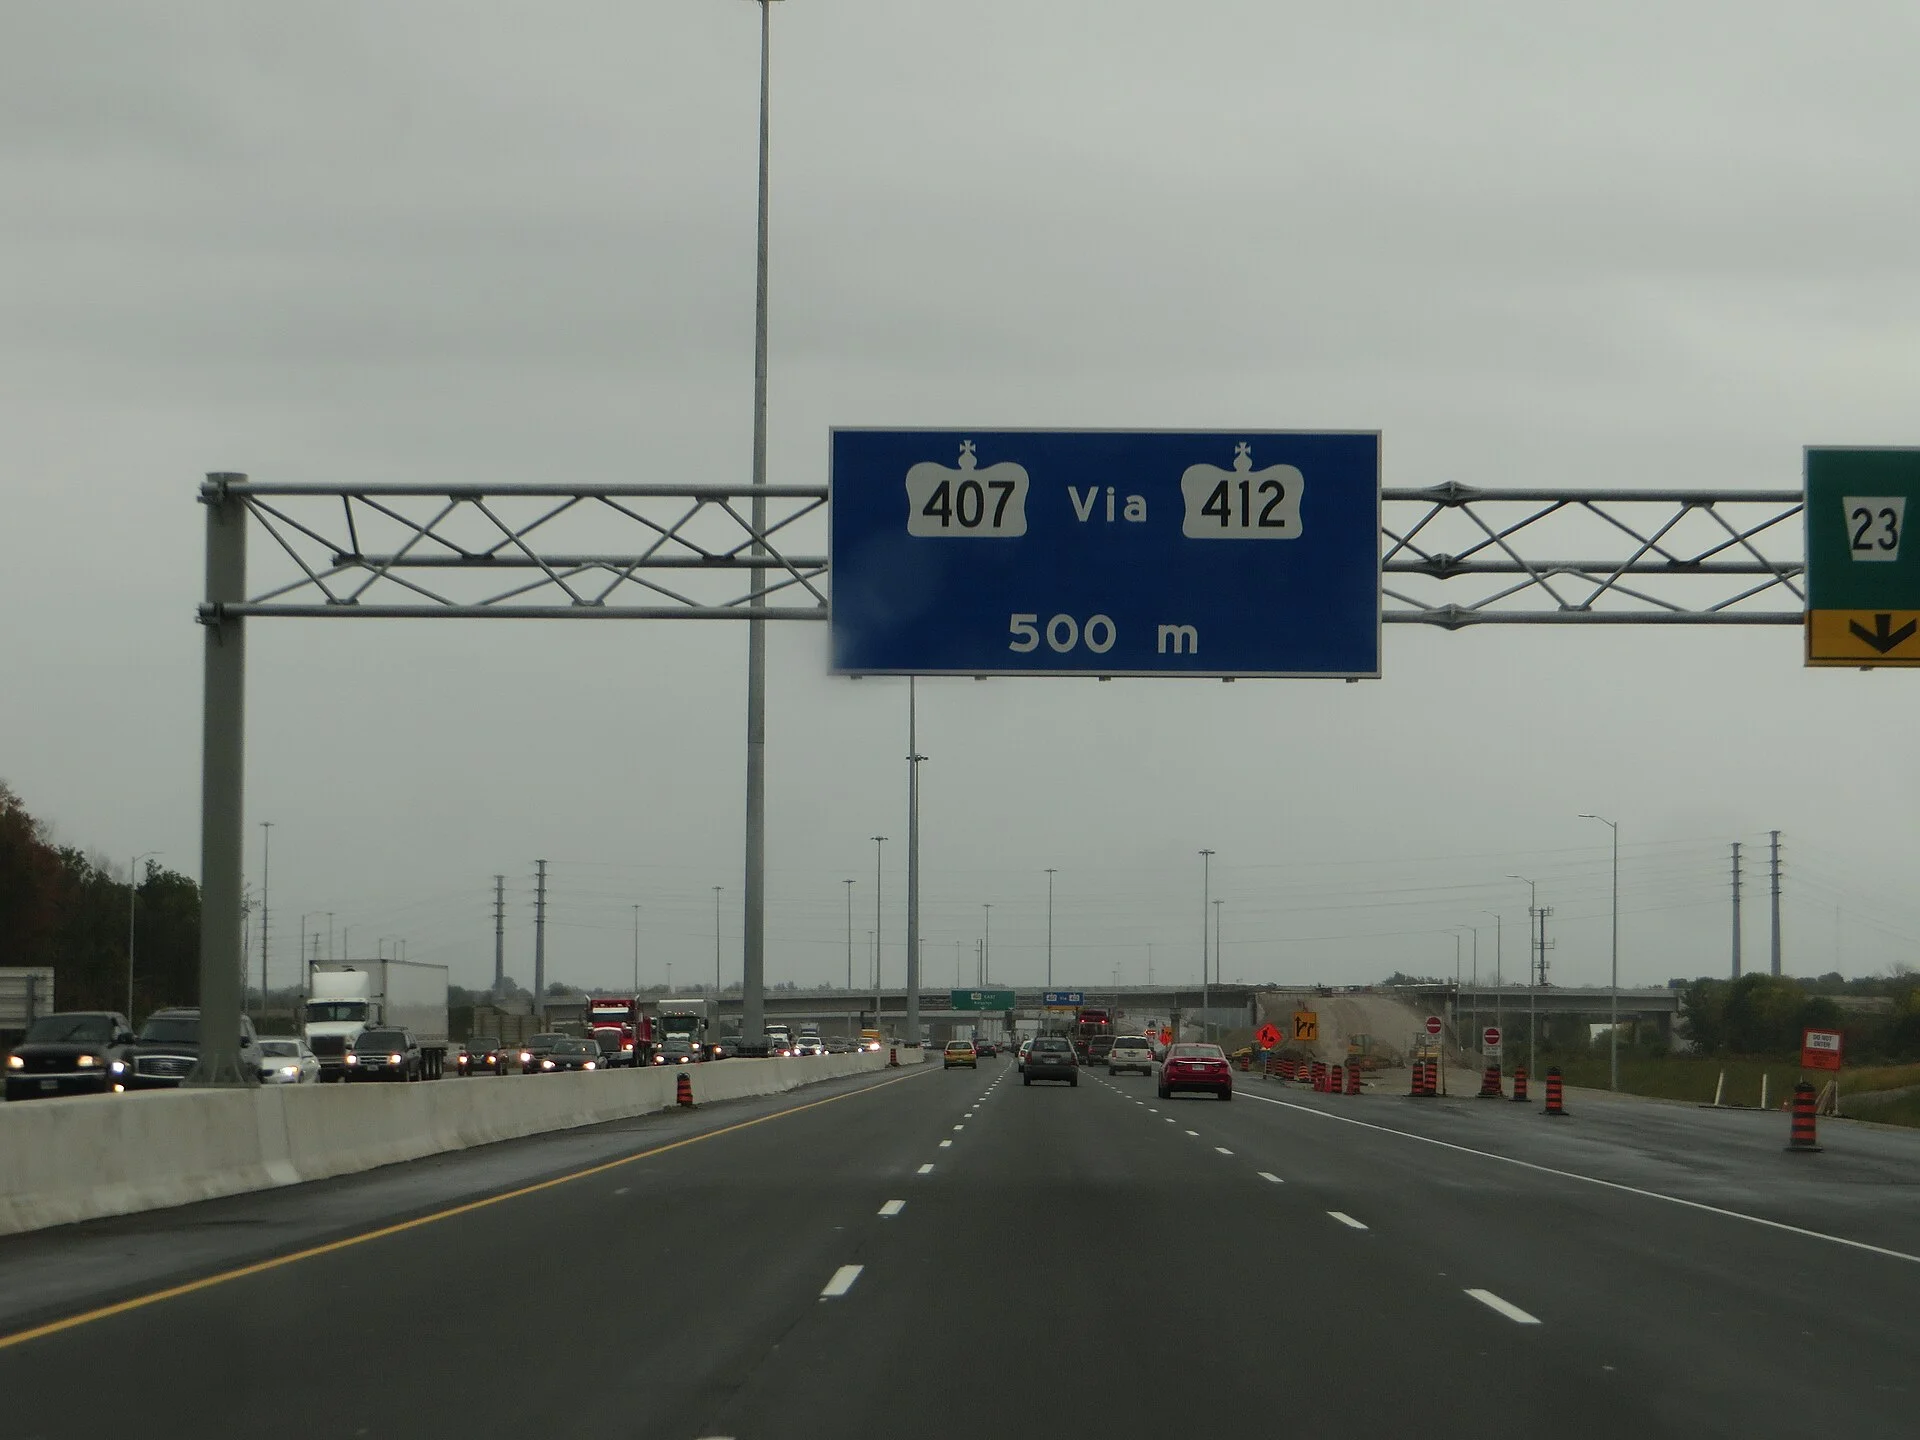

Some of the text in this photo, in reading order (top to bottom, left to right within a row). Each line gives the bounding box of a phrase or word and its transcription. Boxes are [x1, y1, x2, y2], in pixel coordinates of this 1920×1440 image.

[922, 479, 1286, 528] 407 Via 412
[1851, 507, 1899, 551] 23
[1009, 613, 1199, 654] 500 m
